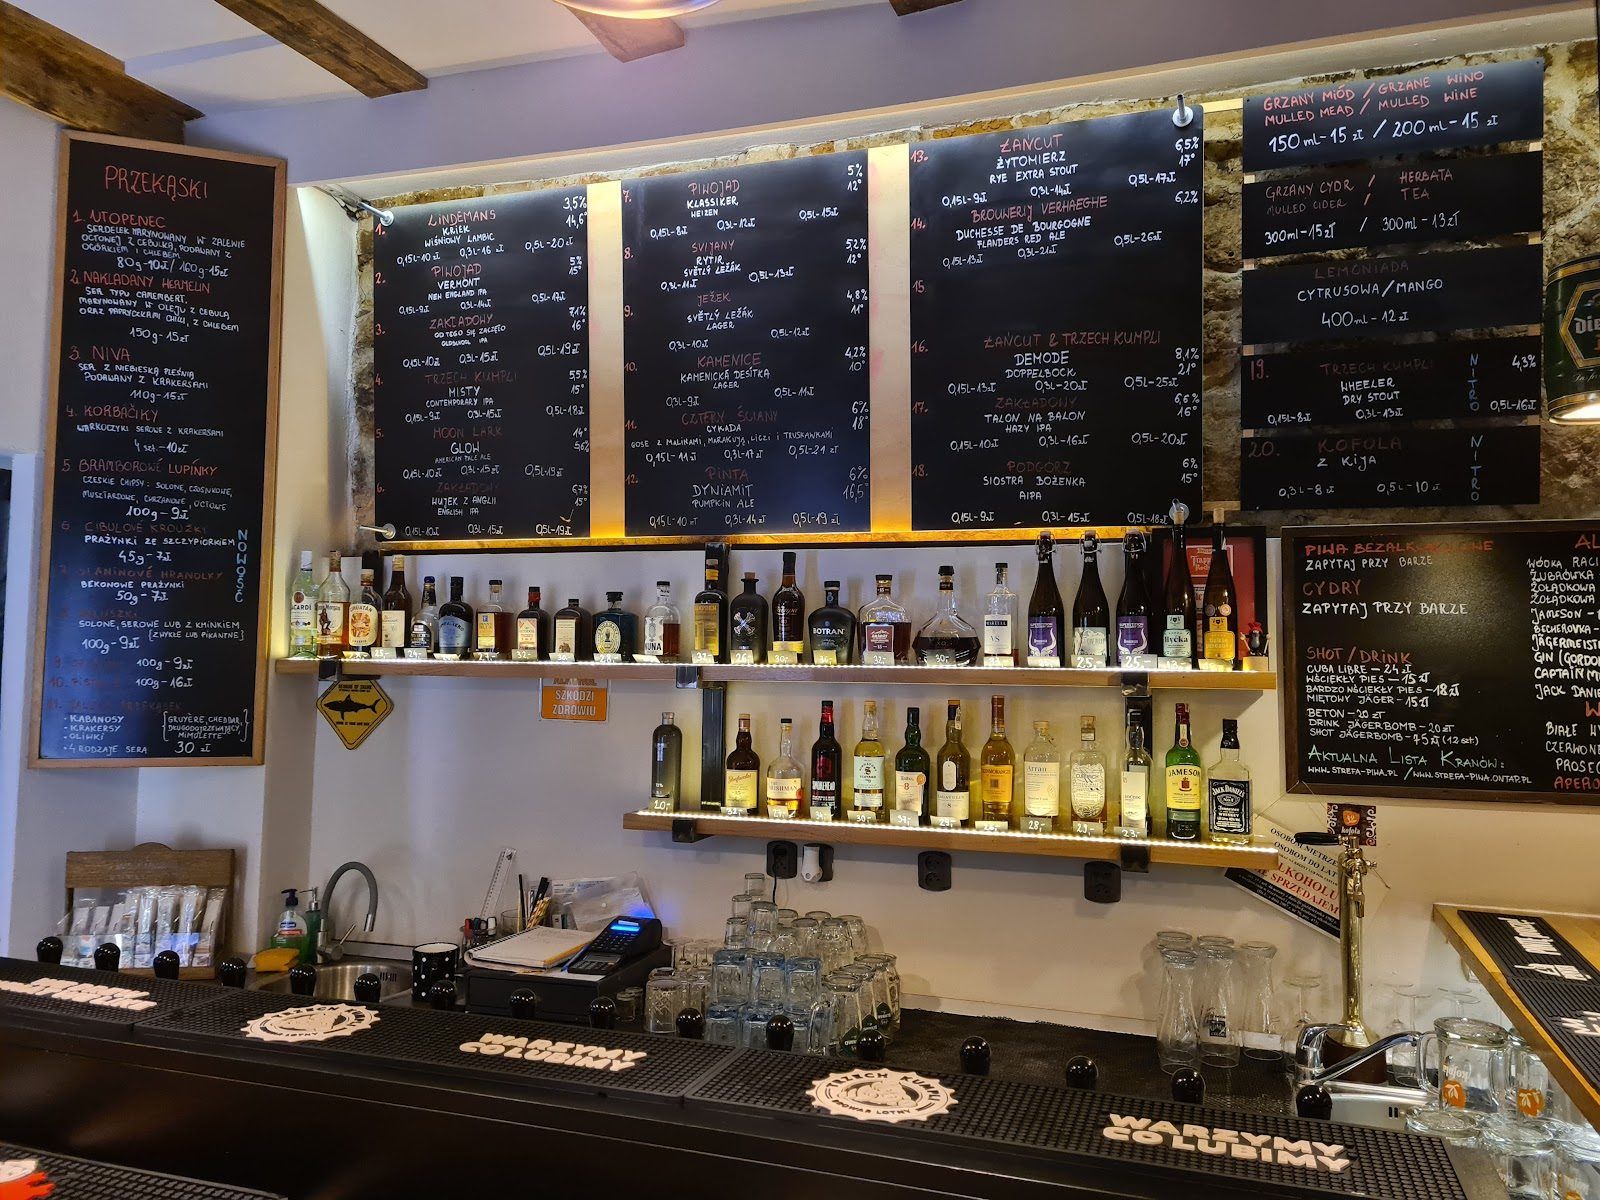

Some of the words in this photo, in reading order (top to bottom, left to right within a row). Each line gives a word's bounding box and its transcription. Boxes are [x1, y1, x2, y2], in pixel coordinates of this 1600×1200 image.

[1264, 92, 1314, 111] GRZANY
[1323, 86, 1355, 102] MIÓD
[1378, 77, 1430, 95] GRZANE
[1447, 71, 1485, 86] WINO
[1265, 109, 1315, 126] MULLED
[1320, 106, 1354, 118] MEAD
[1378, 96, 1430, 111] MULLED
[1444, 89, 1478, 102] WINE
[1176, 137, 1199, 151] 6,5%
[688, 180, 740, 196] PIWOJAD
[847, 164, 863, 177] 5%
[990, 173, 1007, 184] RYE
[1016, 170, 1044, 182] EXTRA
[1050, 164, 1078, 177] STOUT
[1400, 169, 1453, 184] HERBATA
[105, 166, 208, 201] PRZEKĄSKI
[1266, 184, 1313, 200] GRZANY
[1320, 179, 1355, 193] CYDR
[1401, 189, 1430, 200] TEA
[687, 196, 739, 209] KLASSIKER
[1041, 196, 1108, 215] VERHAEGHE
[428, 210, 496, 226] LINDEMANS
[563, 197, 587, 210] 3,5%
[956, 227, 1004, 240] DUCHESSE
[1011, 224, 1024, 233] DE
[1032, 216, 1091, 232] BOURGOGNE
[87, 225, 130, 234] SERDELEK
[212, 238, 245, 248] ZALEWIE
[977, 237, 1019, 249] FLANDERS
[1024, 234, 1041, 243] RED
[1049, 231, 1065, 241] ALE
[431, 264, 482, 278] PIWOJAD
[162, 278, 210, 294] HERMELIN
[438, 278, 480, 290] VERMONT
[86, 287, 103, 296] SER
[110, 288, 130, 298] TYPU
[158, 303, 186, 315] OLEJU
[707, 322, 735, 331] LAGER
[1063, 332, 1109, 346] TRZECH
[1114, 331, 1161, 345] KUMPLI
[92, 346, 130, 361] NIVA
[697, 353, 761, 368] KAMENICE
[1014, 350, 1069, 366] DEMODE
[1176, 348, 1199, 362] 8,1%
[78, 363, 96, 372] SER
[104, 364, 110, 372] Z
[115, 364, 158, 376] NIEBIESKĄ
[1512, 355, 1536, 371] 4,3%
[1006, 368, 1076, 378] DOPPELBOCK
[138, 374, 145, 383] Z
[152, 376, 208, 389] KRAKERSAMI
[713, 381, 739, 389] LAGER
[449, 386, 480, 397] MISTY
[1343, 393, 1363, 405] DRY
[1368, 391, 1400, 401] STOUT
[426, 398, 477, 407] CONTEMPORARY
[984, 413, 1020, 423] TALON
[1028, 413, 1042, 422] NA
[1049, 411, 1086, 421] BALON
[136, 426, 162, 434] SEROWE
[178, 428, 224, 437] KRAKERSAMI
[707, 424, 742, 433] CYKADA
[1006, 424, 1029, 433] HAZY
[1037, 424, 1052, 432] IPA
[450, 442, 480, 454] GLOW
[169, 459, 218, 476] LUPÍNKY
[983, 476, 1024, 486] SIOSTRA
[1183, 458, 1197, 469] 6%
[1020, 491, 1041, 500] AIPA
[737, 499, 755, 508] ALE
[438, 508, 463, 516] ENGLISH
[145, 536, 157, 544] ZE
[1306, 559, 1355, 571] ZAPYTAJ
[1362, 558, 1388, 568] PRZY
[1399, 556, 1432, 567] BARZE
[1530, 569, 1594, 581] ŻUBRÓWKA
[1304, 580, 1361, 596] CYDRY
[1302, 602, 1368, 618] ZAPYTAJ
[1373, 602, 1413, 614] PRZY
[1420, 603, 1468, 615] BARZE
[1531, 608, 1582, 624] JAMESON
[121, 620, 158, 628] SEROWE
[1534, 623, 1591, 634] BECHEROVKA
[1307, 647, 1342, 661] SHOT
[1307, 665, 1334, 674] CUBA
[1360, 675, 1384, 683] PIES
[555, 689, 594, 701] SZKODZI
[1306, 685, 1344, 694] BARDZO
[1398, 686, 1423, 694] PIES
[1535, 684, 1566, 700] JACK
[552, 704, 596, 716] ZDROWIU
[1307, 709, 1344, 718] BETON
[1309, 719, 1340, 727] DRINK
[78, 744, 118, 755] RODZAJE
[126, 745, 147, 753] SERA
[1308, 858, 1320, 870] DO
[1271, 873, 1338, 915] SPRZEDAJEM
[479, 1033, 647, 1061] WARZYMY
[1109, 1113, 1345, 1157] WARZYMY
[1103, 1126, 1163, 1145] CO
[1172, 1135, 1350, 1173] LUBIMY
